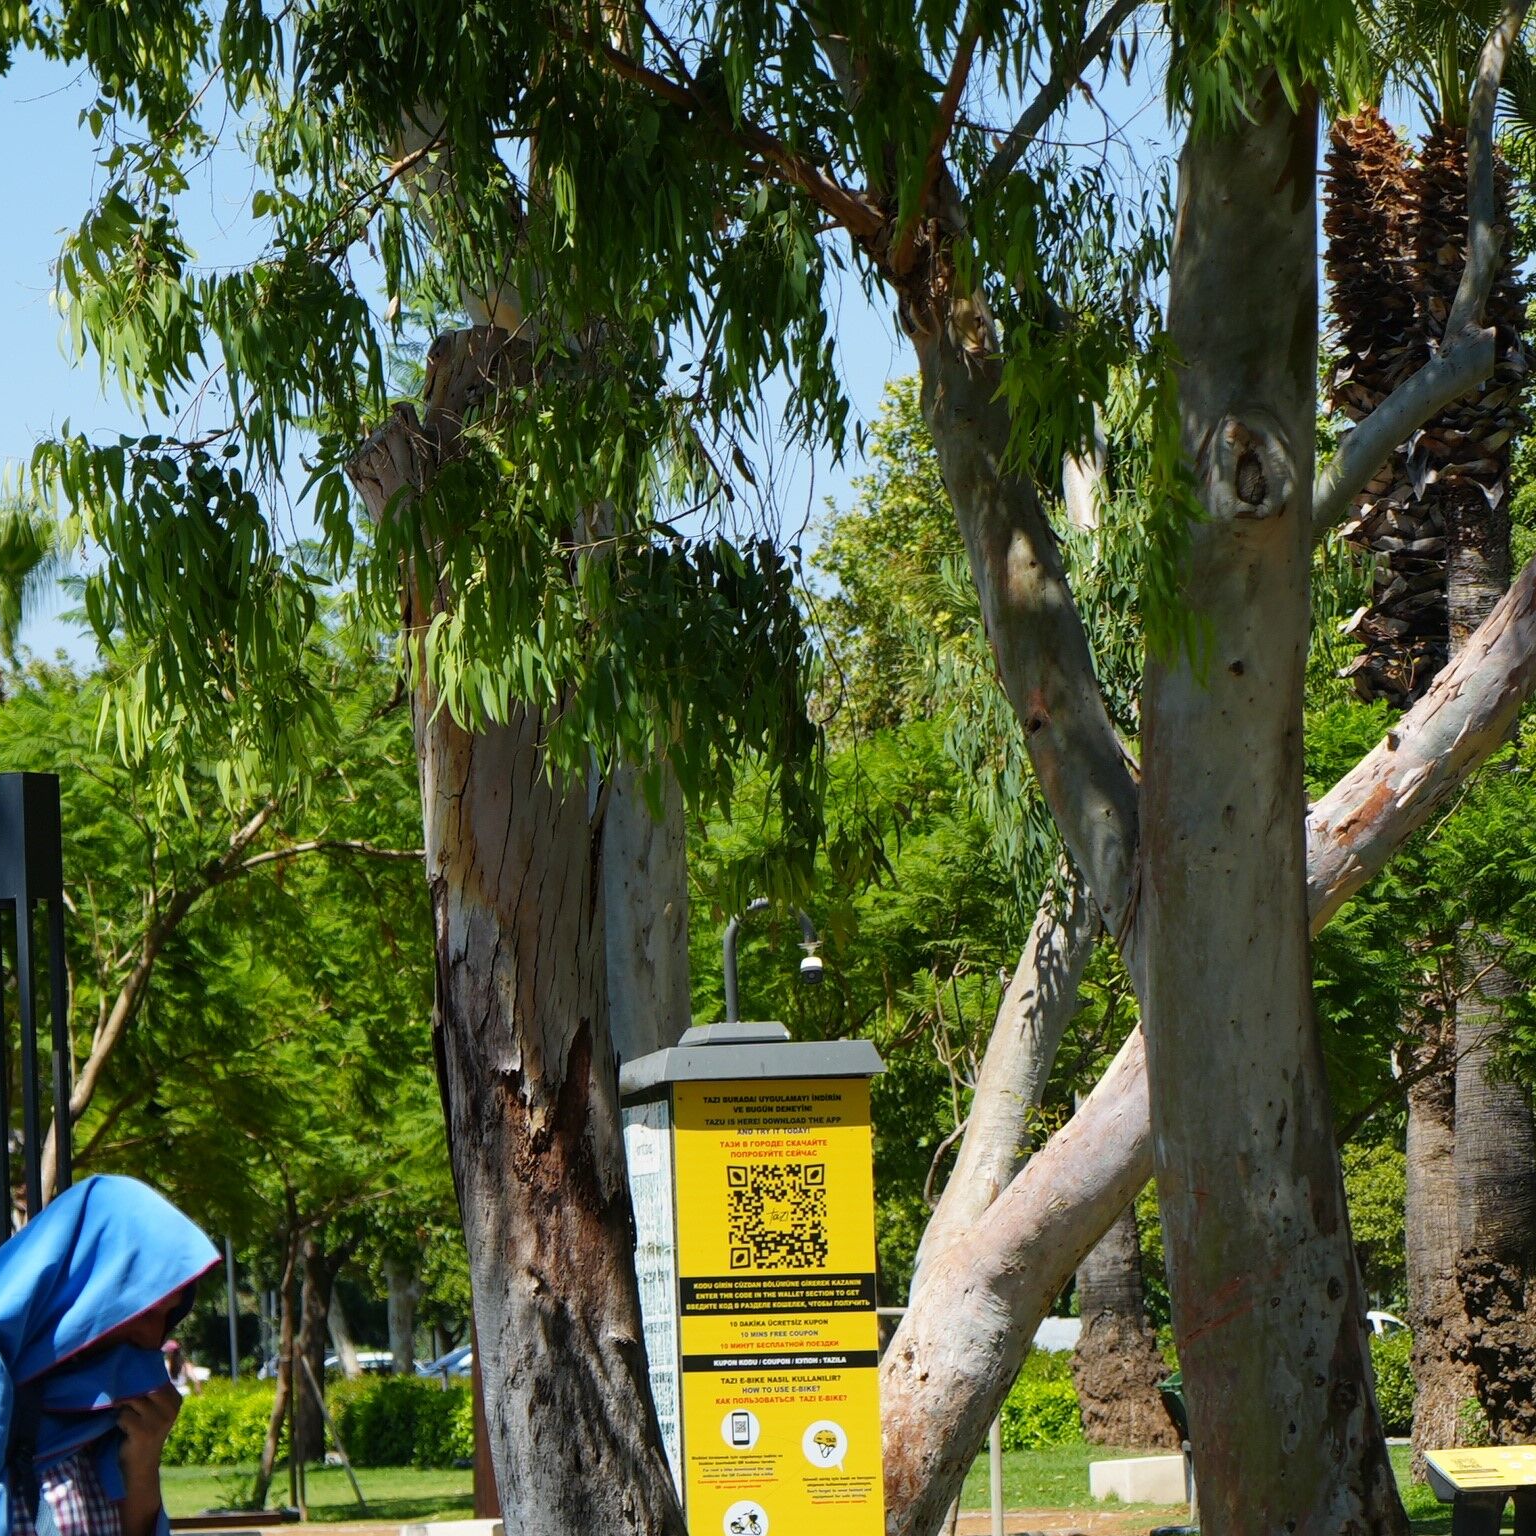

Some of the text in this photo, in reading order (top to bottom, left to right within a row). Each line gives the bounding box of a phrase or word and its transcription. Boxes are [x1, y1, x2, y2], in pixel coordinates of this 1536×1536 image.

[762, 1117, 806, 1125] DOWNLOAD
[826, 1116, 841, 1124] APP
[754, 1291, 762, 1299] IN
[777, 1290, 804, 1298] WALLET
[791, 1385, 821, 1393] E-BIKE?
